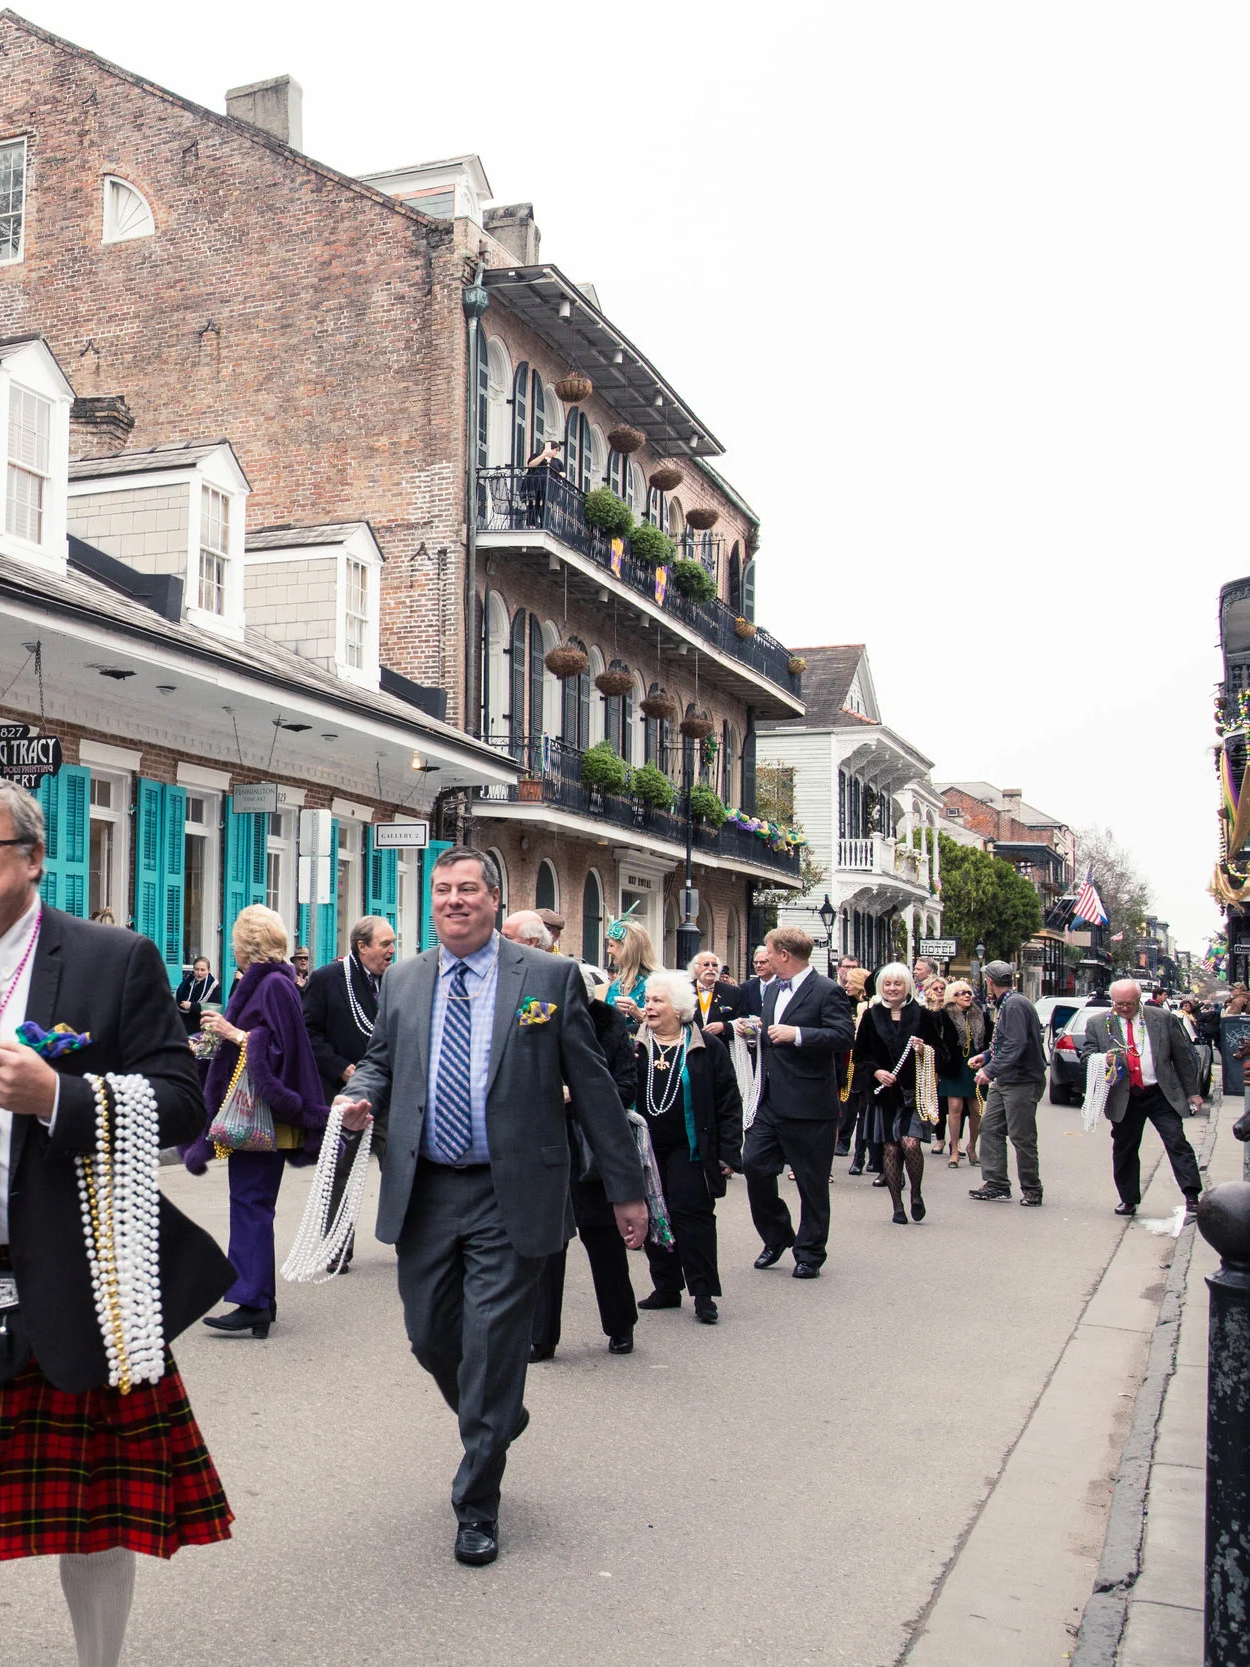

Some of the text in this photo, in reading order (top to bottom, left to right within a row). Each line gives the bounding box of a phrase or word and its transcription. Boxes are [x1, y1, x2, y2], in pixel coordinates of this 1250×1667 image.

[0, 728, 23, 737] 827
[11, 739, 56, 764] TRACY
[921, 945, 955, 954] HOTEL
